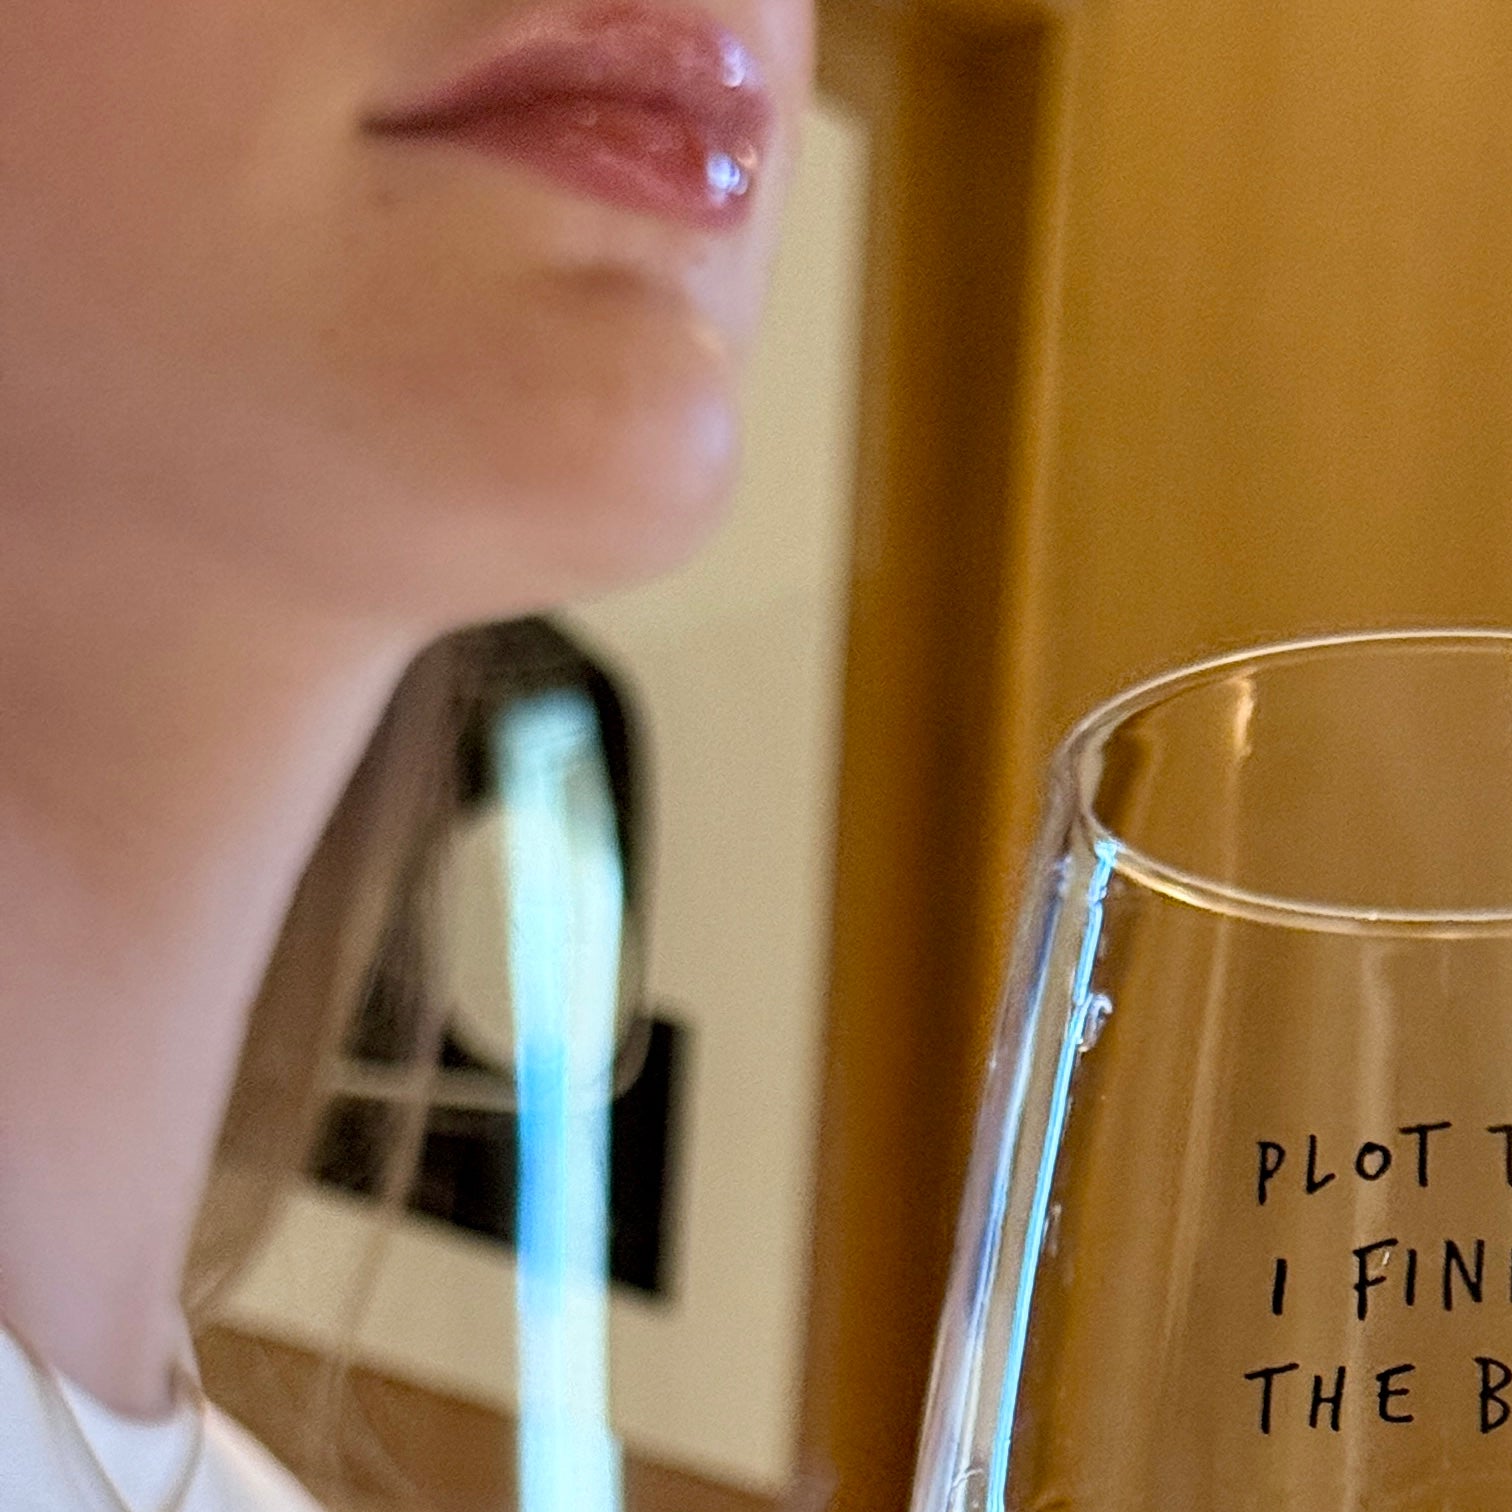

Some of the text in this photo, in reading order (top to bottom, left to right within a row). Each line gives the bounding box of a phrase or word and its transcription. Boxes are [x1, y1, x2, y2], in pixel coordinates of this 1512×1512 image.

[1255, 1121, 1453, 1207] PLOT
[1270, 1256, 1289, 1317] I
[1243, 1361, 1417, 1436] THE
